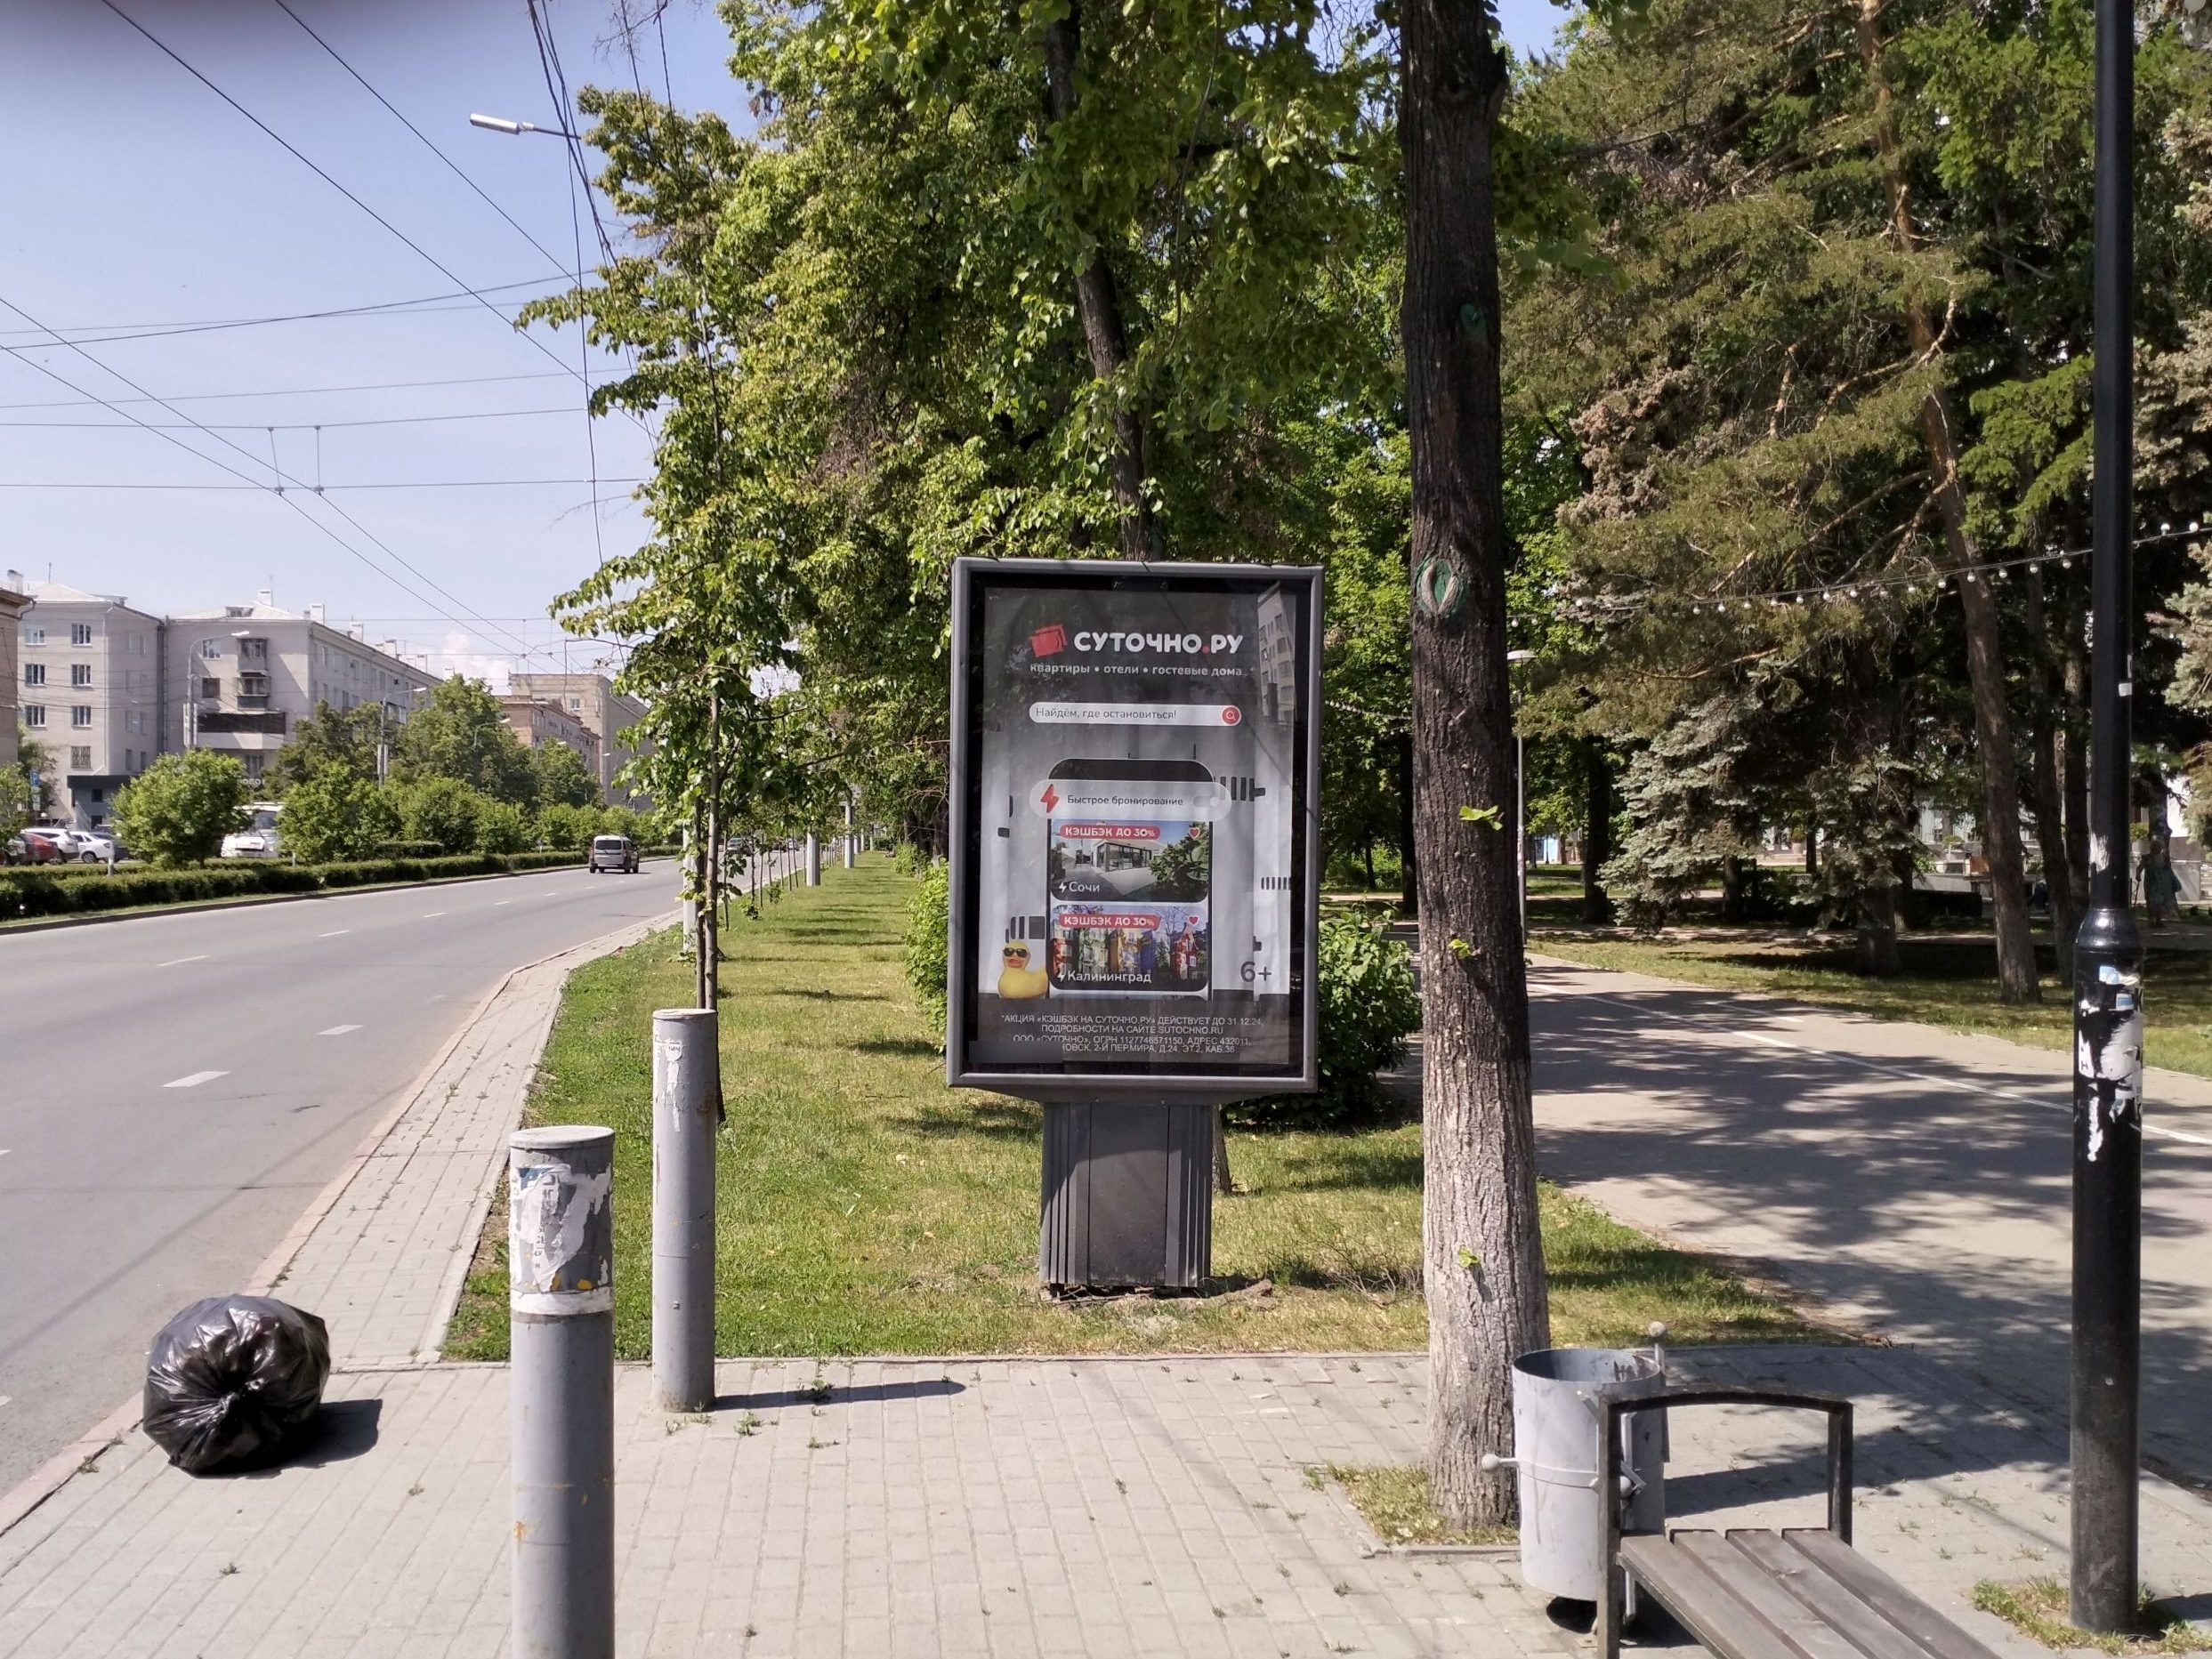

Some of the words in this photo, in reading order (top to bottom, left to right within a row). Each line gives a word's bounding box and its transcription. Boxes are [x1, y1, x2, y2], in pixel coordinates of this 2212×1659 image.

[1073, 632, 1244, 654] СУТОЧНО.РУ
[1029, 664, 1090, 675] квартиры
[1103, 666, 1139, 674] отели
[1152, 667, 1208, 676] гостевые
[1211, 668, 1243, 677] дома
[1036, 708, 1080, 719] Найдём,
[1082, 711, 1101, 720] где
[1103, 711, 1176, 720] остановиться!
[1068, 795, 1110, 806] Быстрое
[1112, 796, 1183, 807] бронирование
[1065, 827, 1112, 837] КЭШБЭК
[1115, 828, 1132, 838] ДО
[1134, 828, 1156, 837] 30%
[1069, 881, 1101, 893] Сочи
[1064, 915, 1111, 926] КЭШБЭК
[1114, 917, 1131, 927] ДО
[1133, 917, 1155, 927] 30%
[1068, 970, 1152, 985] Калининград
[1240, 961, 1272, 983] 6+
[1080, 1016, 1094, 1024] НА
[1158, 1016, 1211, 1025] ДЕЙСТВУЕТ
[1212, 1017, 1225, 1026] ДО
[1041, 1024, 1110, 1034] ПОДРОБНОСТИ
[1111, 1026, 1125, 1034] НА
[1126, 1025, 1156, 1034] САЙТЕ
[1158, 1026, 1223, 1035] SUTOCHNO.RU
[1093, 1035, 1118, 1044] ОГРН
[1187, 1037, 1218, 1045] АДРЕС
